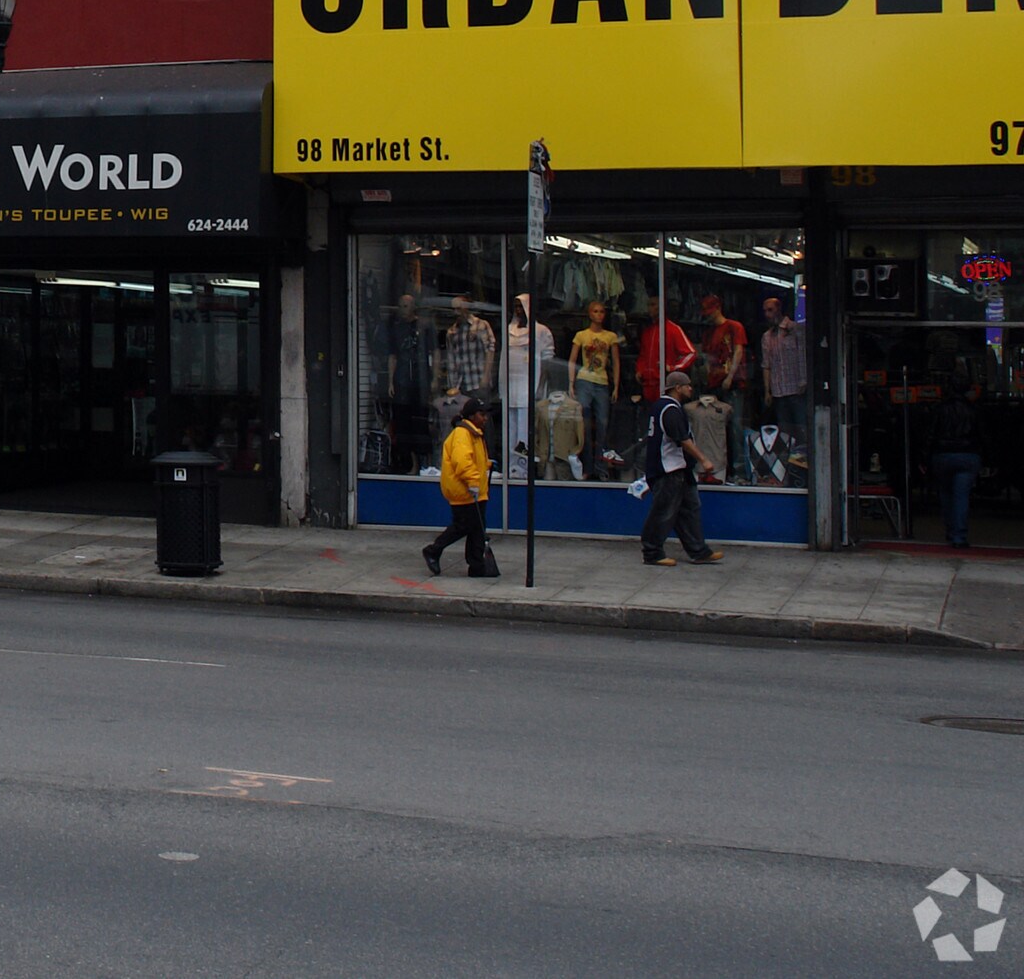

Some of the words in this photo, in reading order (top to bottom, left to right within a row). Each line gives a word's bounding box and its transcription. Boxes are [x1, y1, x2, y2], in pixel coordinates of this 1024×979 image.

[295, 138, 323, 163] 98
[330, 137, 412, 163] Market
[419, 136, 451, 162] St.
[831, 166, 879, 187] 98
[31, 208, 113, 222] TOUPEE
[130, 207, 170, 221] WIG
[186, 218, 250, 233] 624-2444
[960, 260, 1013, 279] OPEN
